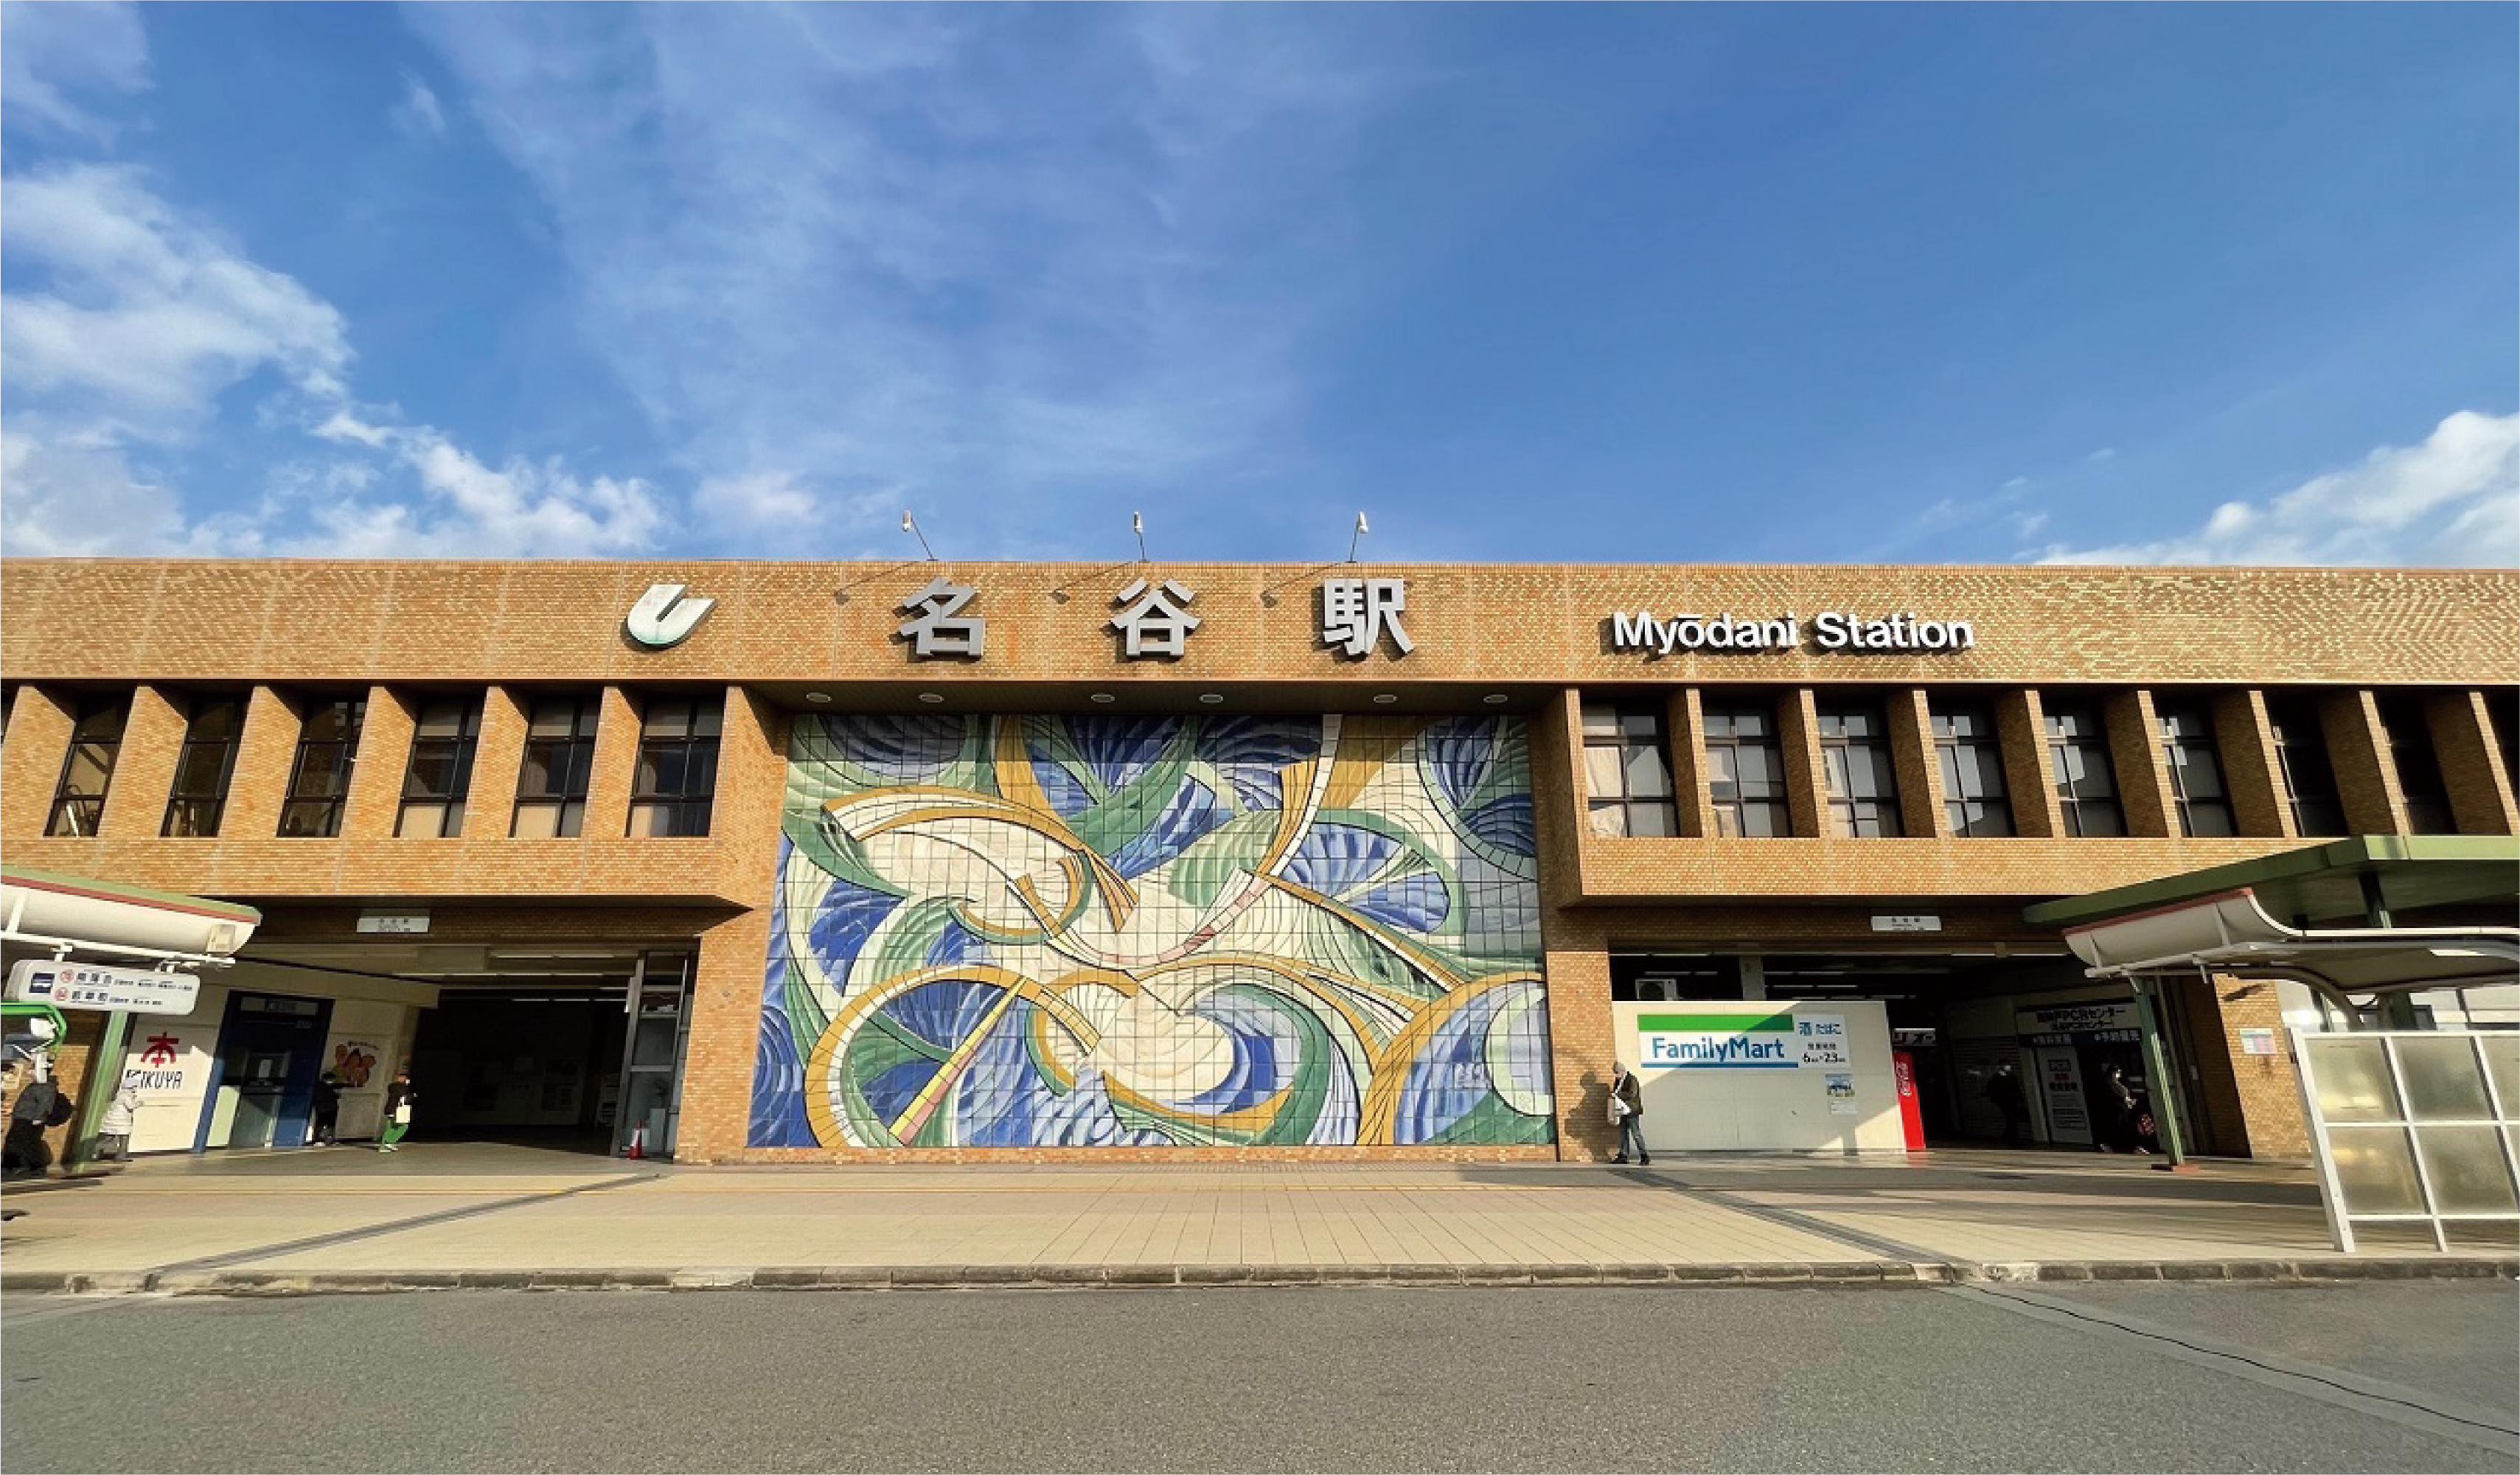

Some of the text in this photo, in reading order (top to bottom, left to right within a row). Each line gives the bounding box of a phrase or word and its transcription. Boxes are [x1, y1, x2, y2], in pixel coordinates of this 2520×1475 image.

[898, 576, 1414, 658] 名谷駅
[1612, 610, 1974, 654] Myōdani Station
[1651, 1036, 1785, 1062] FamilyMart
